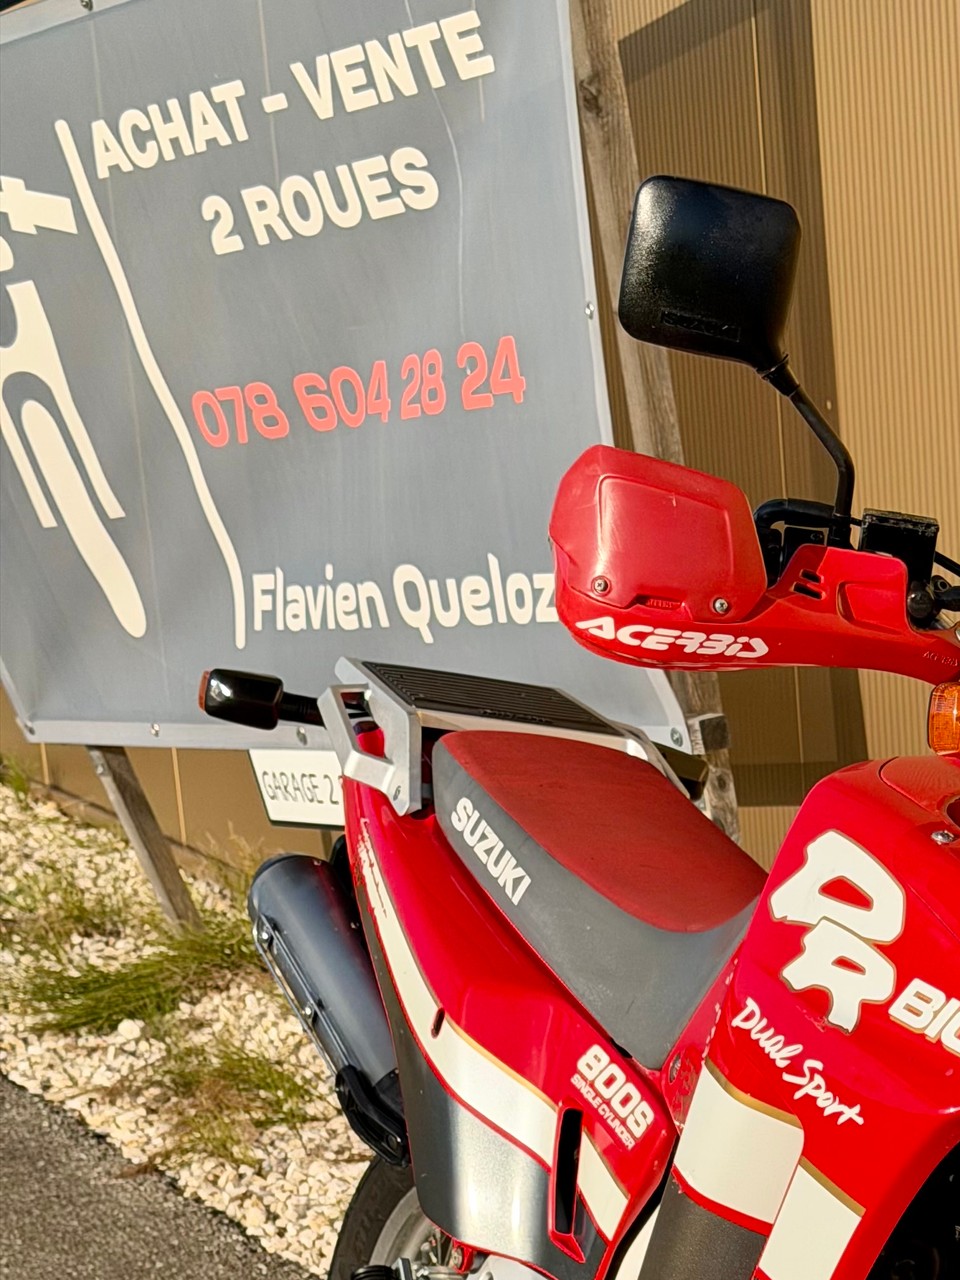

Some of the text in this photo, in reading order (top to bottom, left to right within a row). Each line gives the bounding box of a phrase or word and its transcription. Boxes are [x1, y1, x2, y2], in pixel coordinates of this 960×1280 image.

[91, 10, 496, 179] ACHAT - VENTE
[201, 146, 440, 256] 2 ROUES
[191, 336, 527, 447] 078 604 28 24
[252, 552, 559, 645] Flavien Queloz
[575, 616, 769, 659] ACERBIS
[261, 770, 325, 805] GARAGE
[451, 797, 532, 906] SUZUKI
[570, 1073, 636, 1151] SINGLE CYLINDER
[577, 1044, 655, 1139] 800S
[731, 997, 865, 1128] Dual Sport
